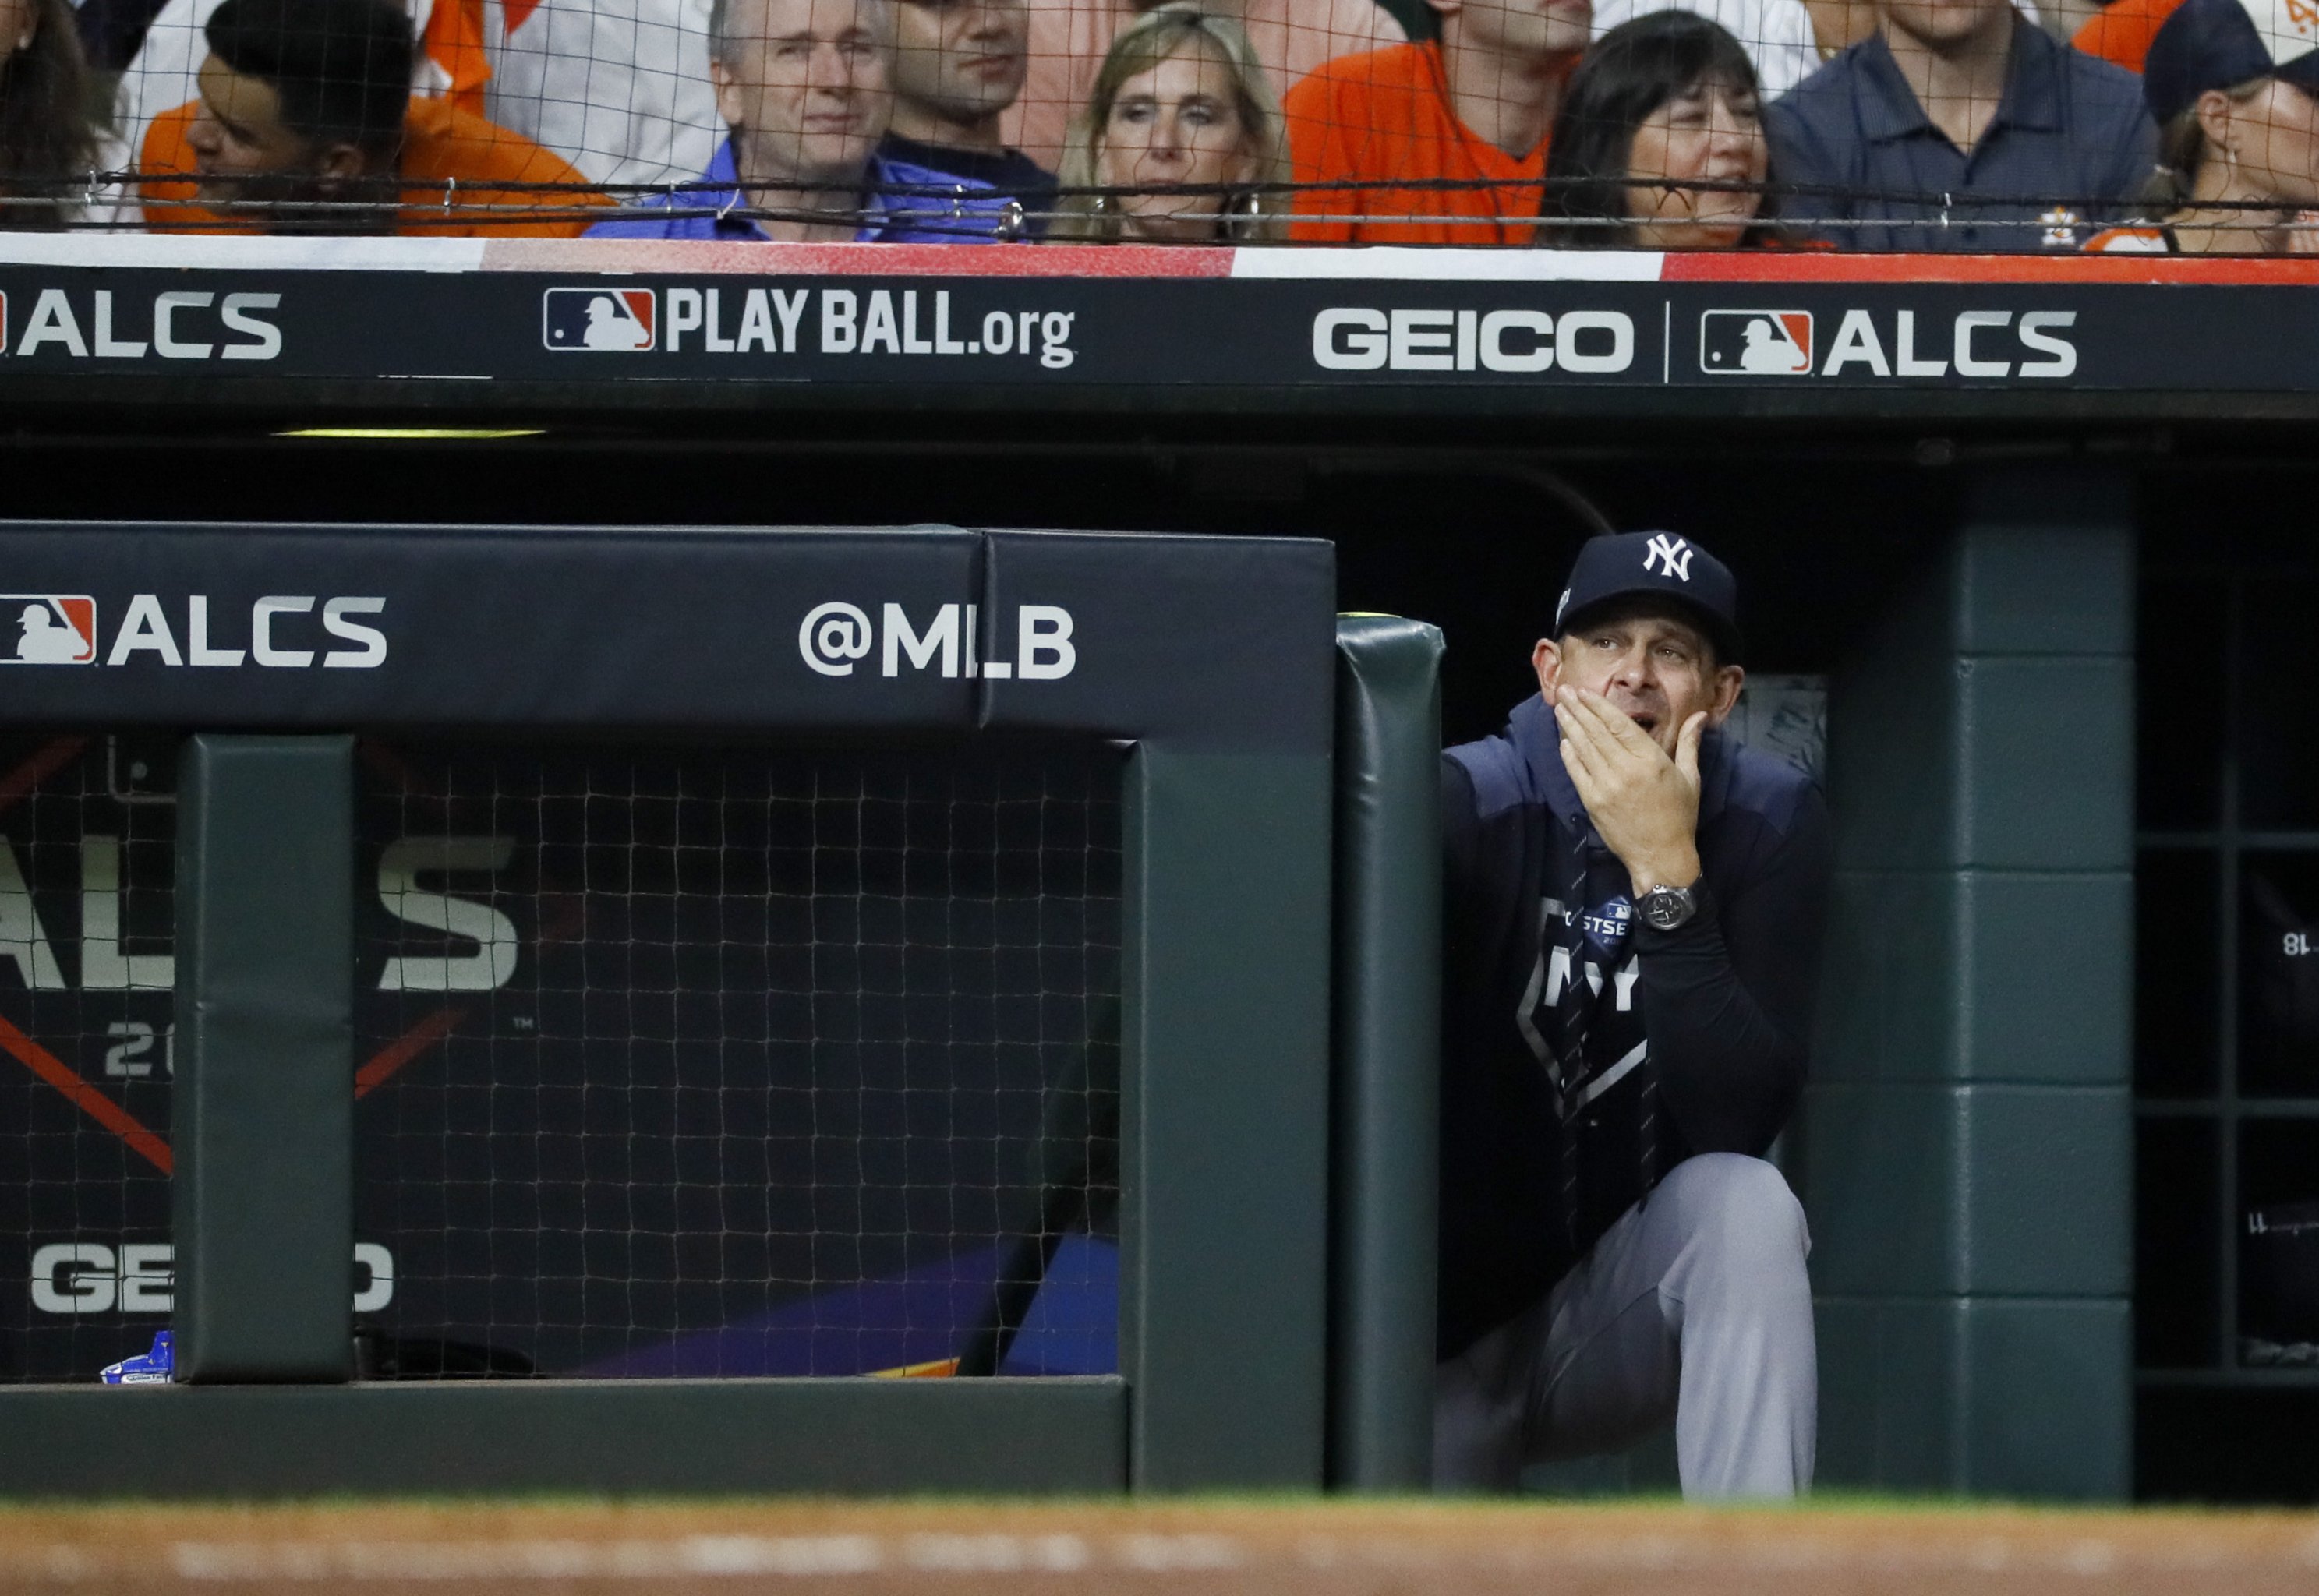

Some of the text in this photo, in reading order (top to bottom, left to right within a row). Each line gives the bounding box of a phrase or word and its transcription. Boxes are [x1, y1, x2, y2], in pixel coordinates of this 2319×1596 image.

[16, 289, 281, 359] ALCS
[666, 288, 809, 352] PLAY
[1313, 308, 1634, 373] GEICO
[1822, 309, 2077, 377] ALCS
[1643, 534, 1693, 582] NY
[107, 595, 387, 668] ALCS
[799, 602, 1076, 680] @MLB
